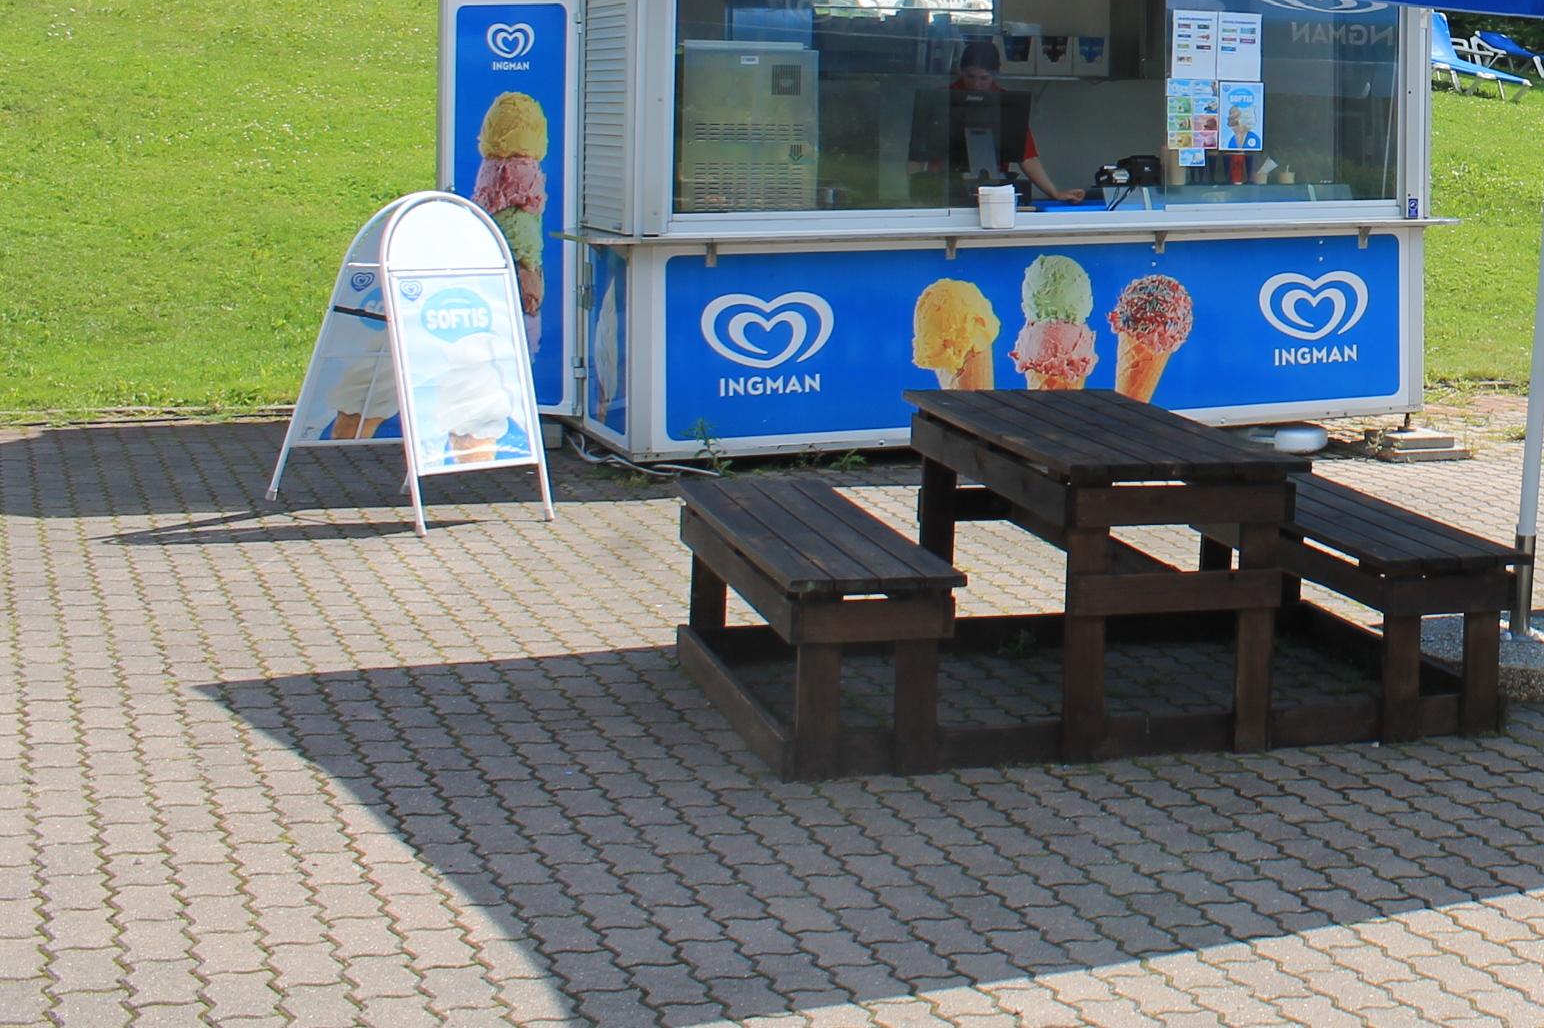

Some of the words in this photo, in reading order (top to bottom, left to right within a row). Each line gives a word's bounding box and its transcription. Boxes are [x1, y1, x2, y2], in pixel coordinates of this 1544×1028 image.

[492, 61, 530, 70] INGMAN
[1229, 94, 1253, 103] SOFTIS
[425, 307, 490, 330] SOFTIS
[1274, 344, 1357, 366] INGMAN
[719, 373, 821, 397] INGMAN
